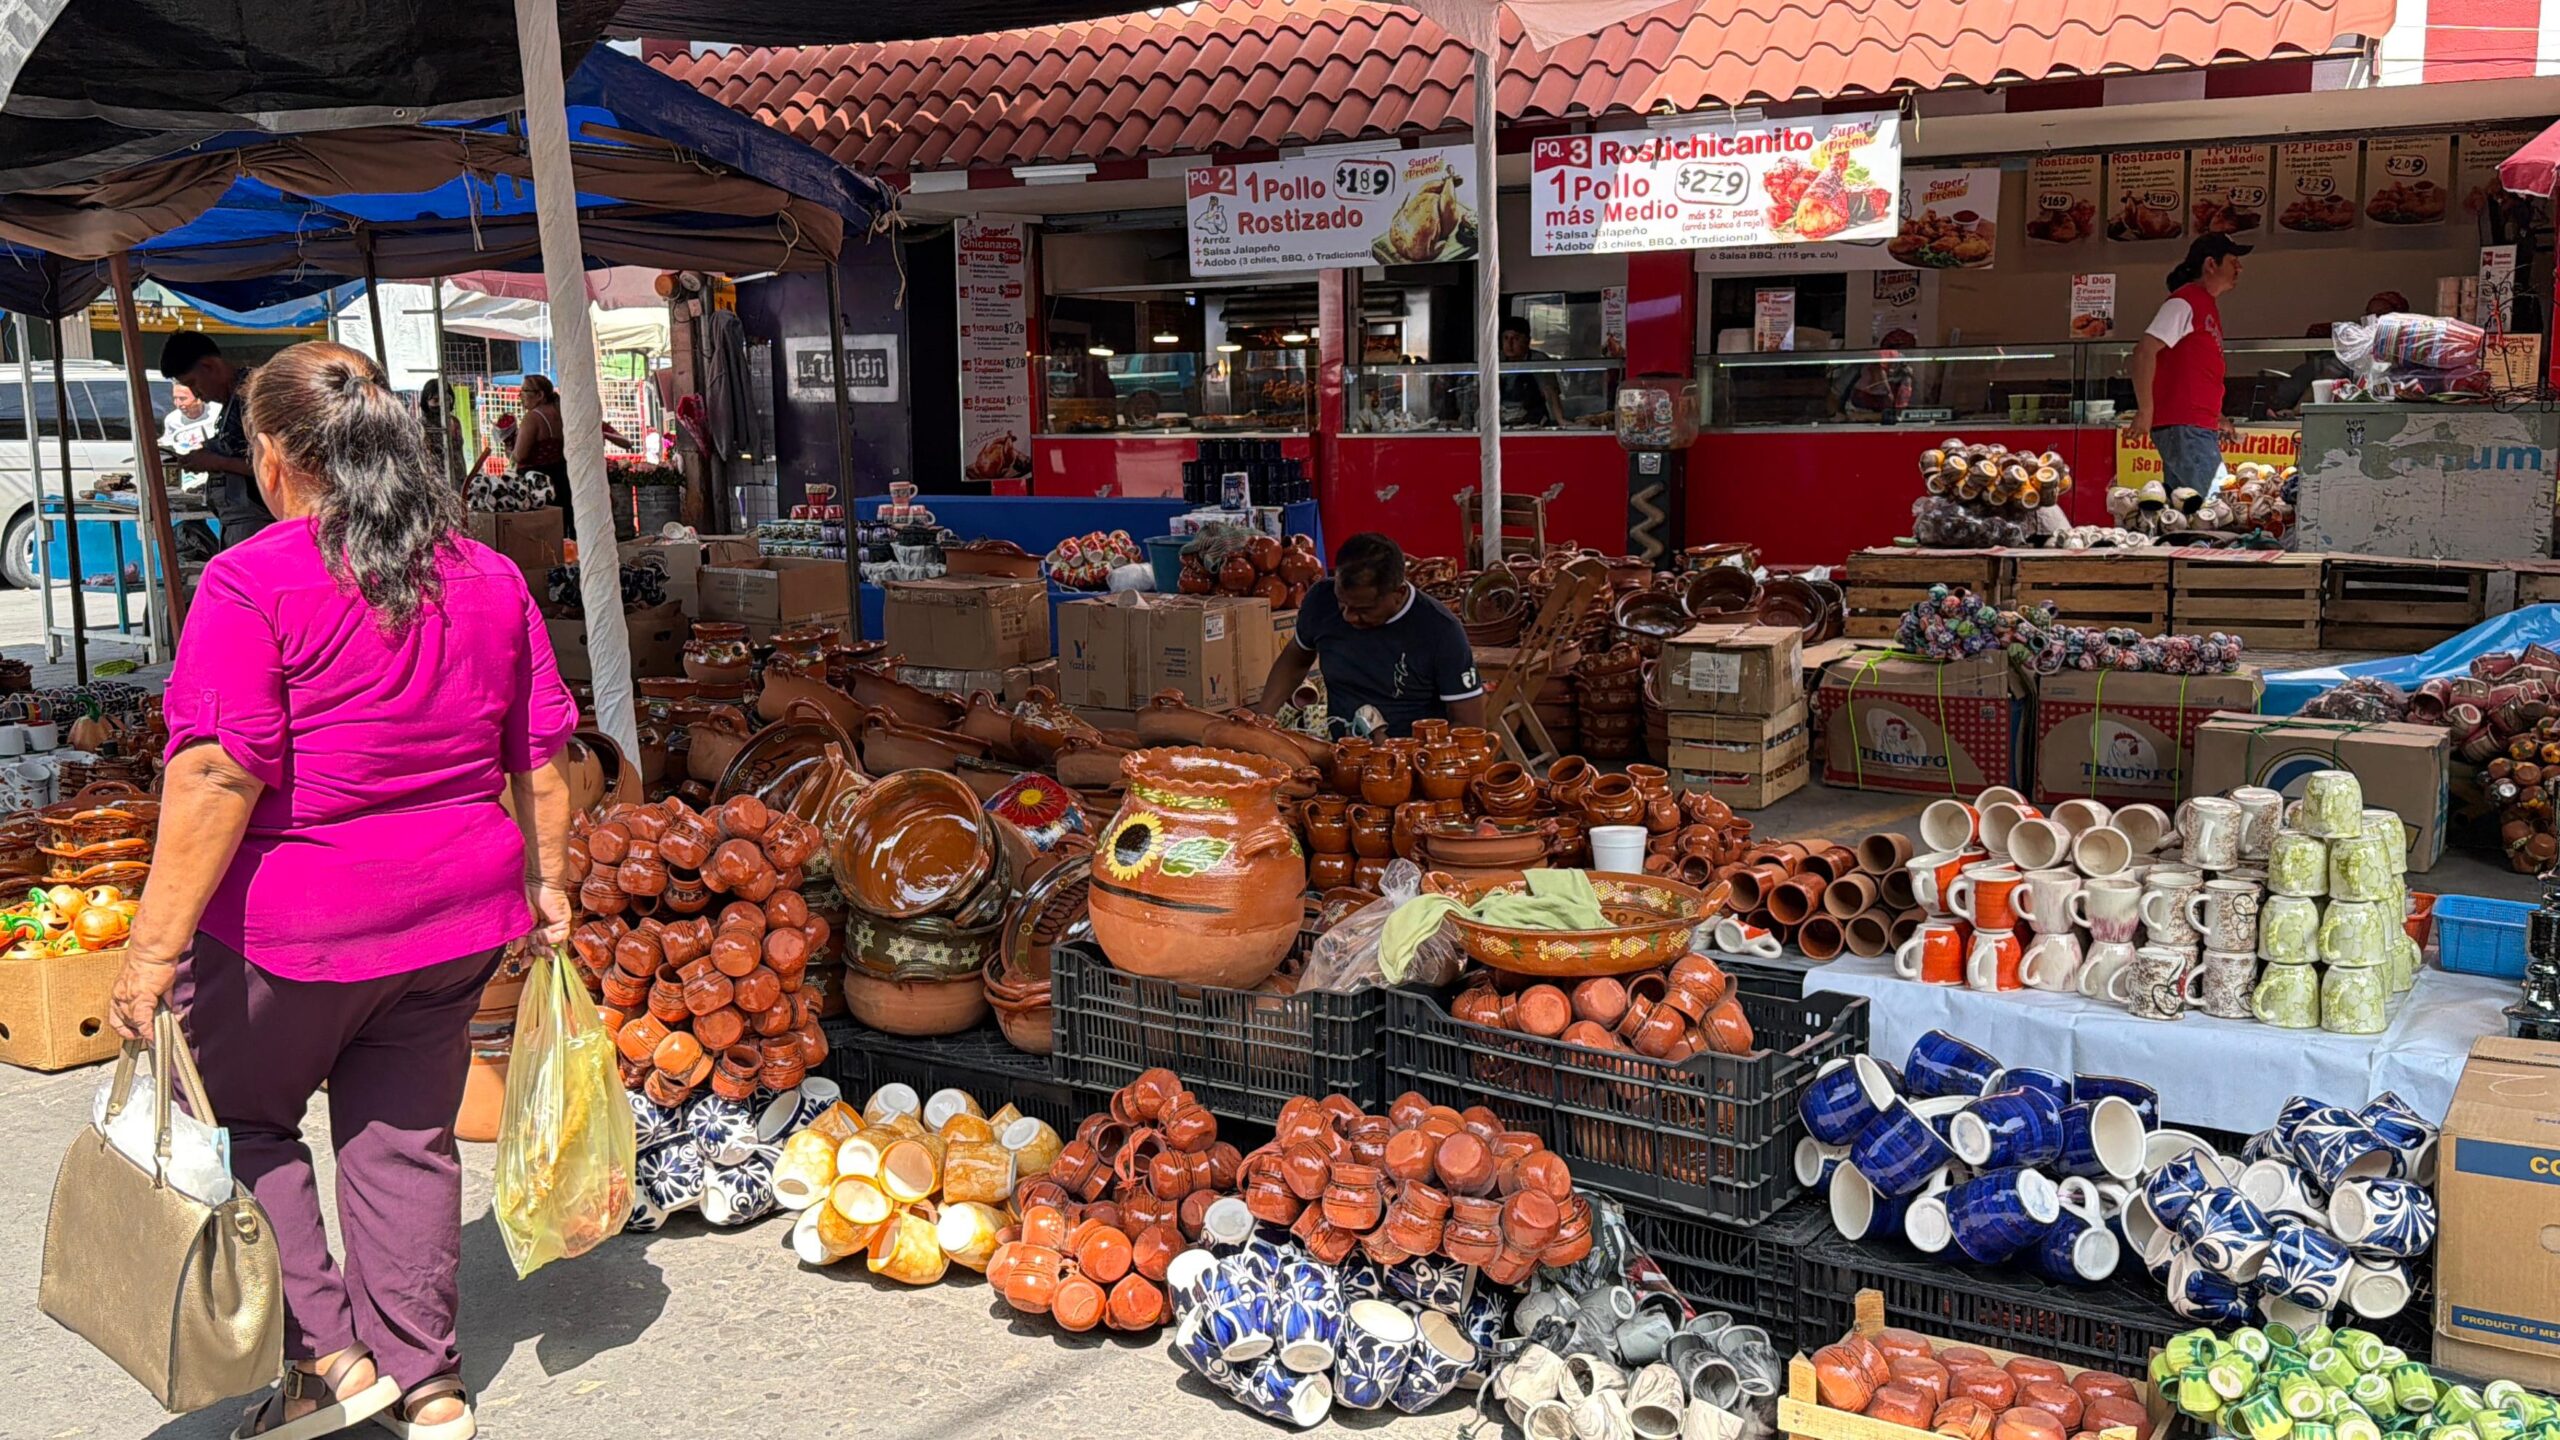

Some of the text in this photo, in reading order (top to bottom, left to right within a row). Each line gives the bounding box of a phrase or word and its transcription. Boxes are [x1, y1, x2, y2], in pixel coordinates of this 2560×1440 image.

[1537, 138, 1588, 165] PQ. 3
[1600, 127, 1813, 166] Rostichicanito
[2283, 141, 2353, 155] 12 Piezas
[2036, 156, 2095, 168] Rostizado
[2112, 150, 2181, 165] Rostizado
[2201, 154, 2265, 166] más Medio
[2386, 158, 2424, 173] $209
[1188, 167, 1233, 191] PQ. 2
[1245, 166, 1389, 203] 1 Pollo $189
[1550, 168, 1566, 204] 1
[1574, 172, 1650, 202] Pollo
[2295, 176, 2332, 192] $229
[2041, 195, 2068, 207] $169
[1237, 205, 1363, 235] Rostizado
[1546, 199, 1679, 227] más Medio
[1688, 211, 1706, 221] más
[1732, 209, 1760, 222] pesos
[1591, 227, 1648, 242] Jalapeño
[1233, 244, 1281, 255] Jalapeño
[1315, 249, 1373, 261] Tradicional)
[1719, 251, 1747, 260] Salsa
[1778, 251, 1798, 261] (115
[1892, 286, 1917, 304] $169
[800, 352, 885, 383] La Uión
[1859, 746, 1948, 769] TRIUNFO
[2081, 761, 2184, 782] TRIUNFO
[2461, 1314, 2518, 1332] PRODUCT
[2520, 1325, 2537, 1335] OF
